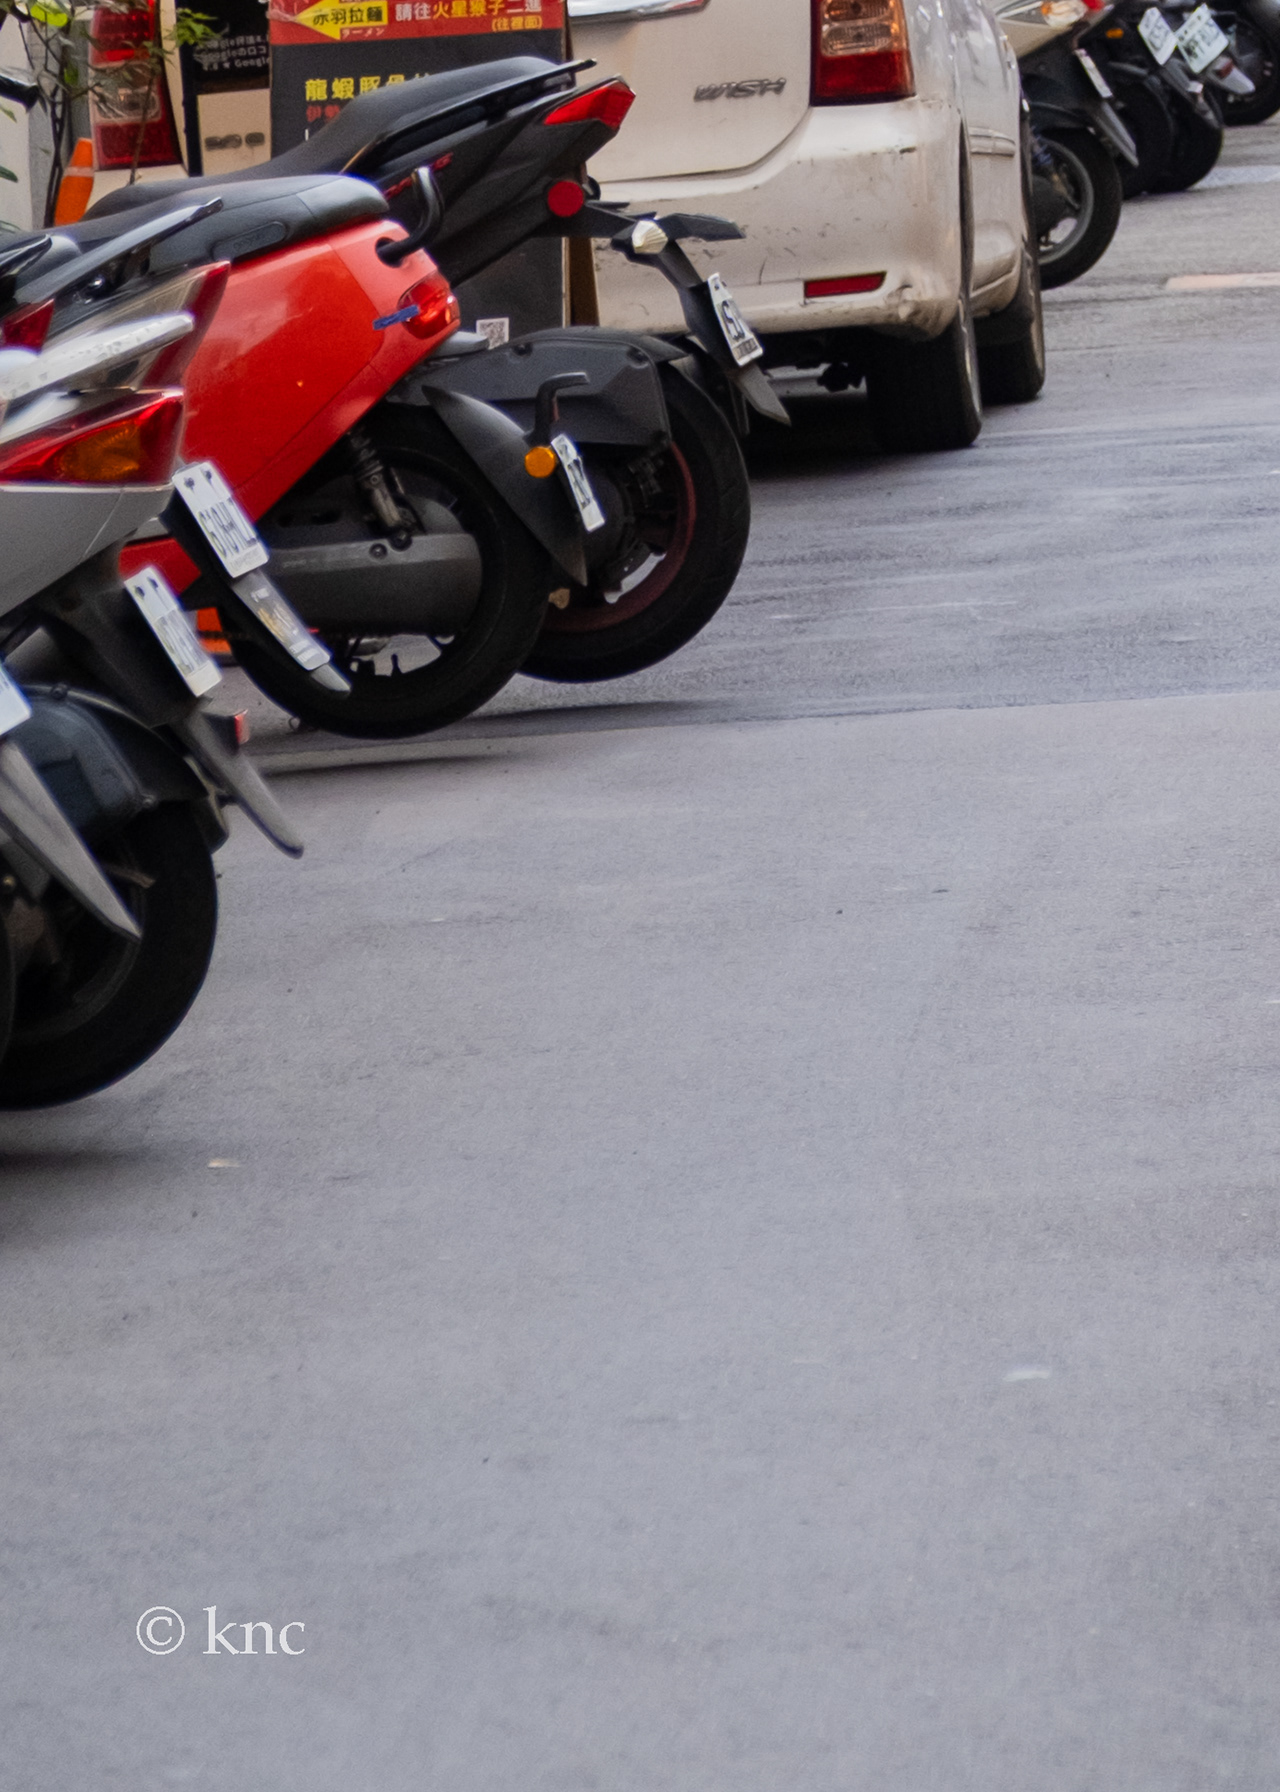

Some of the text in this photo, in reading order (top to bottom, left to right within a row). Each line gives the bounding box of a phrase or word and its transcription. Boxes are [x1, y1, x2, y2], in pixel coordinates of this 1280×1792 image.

[313, 6, 384, 27] 赤羽拉麵
[342, 26, 385, 38] ラーメン
[693, 77, 787, 103] WISH
